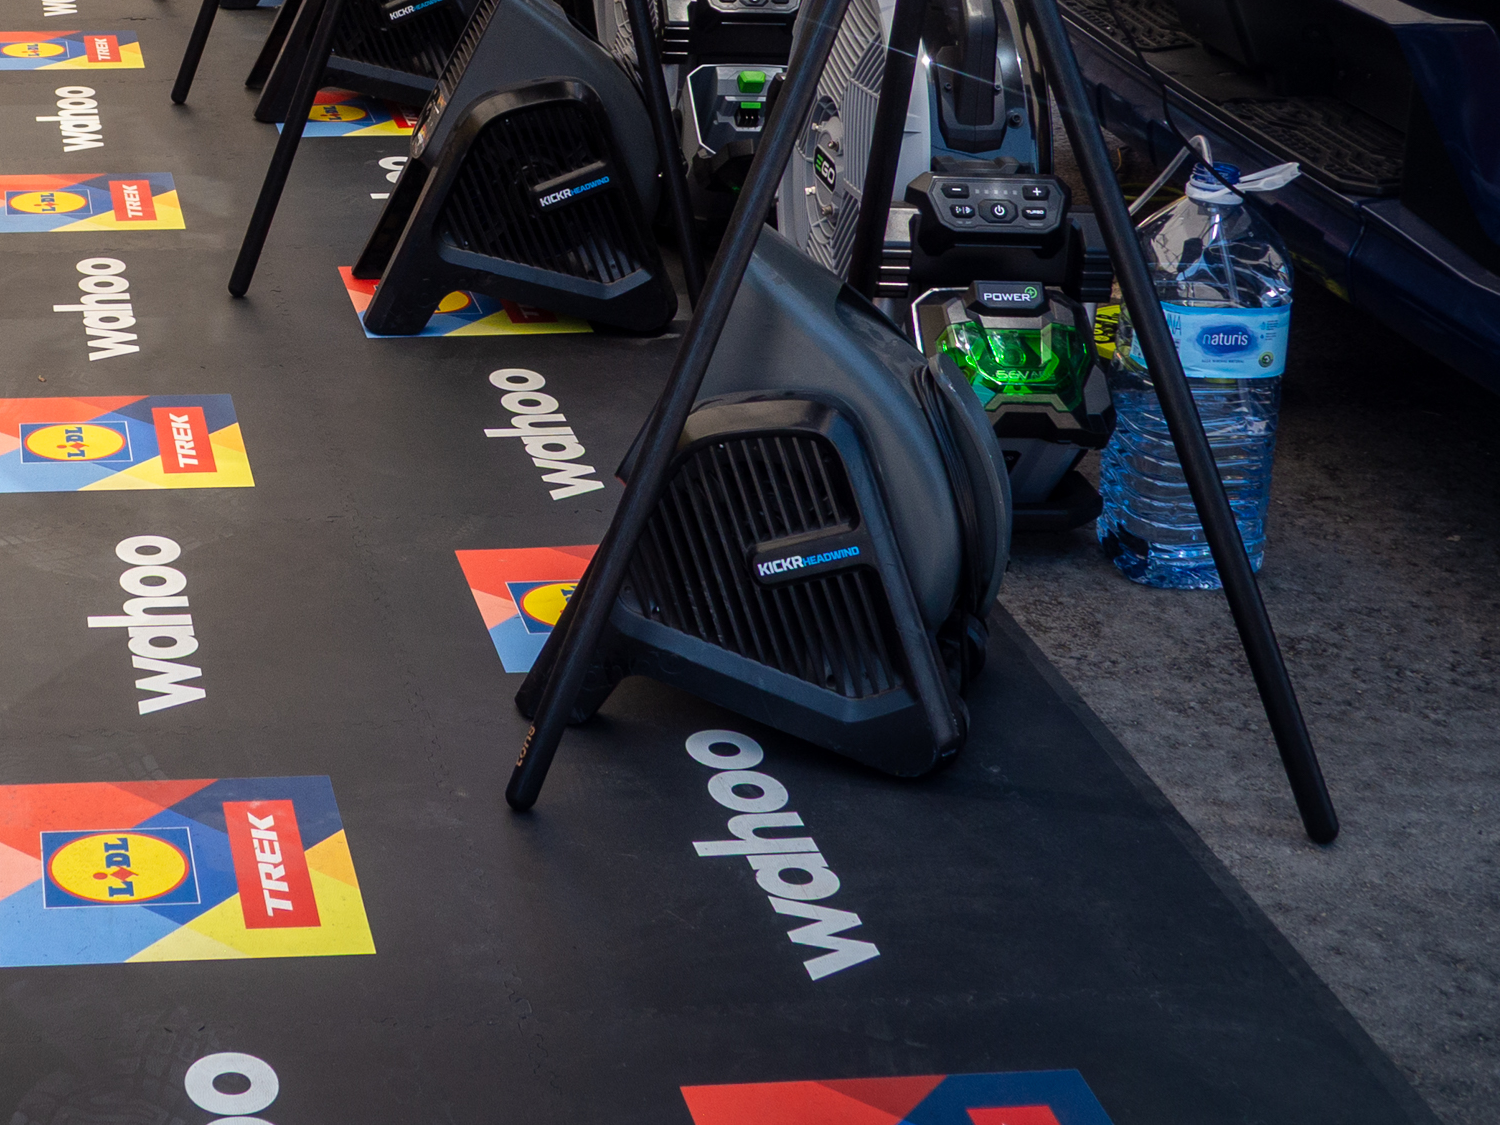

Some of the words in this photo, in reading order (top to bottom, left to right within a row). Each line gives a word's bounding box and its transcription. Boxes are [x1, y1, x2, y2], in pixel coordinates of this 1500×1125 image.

[389, 5, 415, 21] KICKR
[94, 37, 111, 61] TREK
[35, 85, 105, 153] wahoo
[539, 188, 572, 207] KICKR
[570, 175, 610, 197] HEADWIND
[815, 153, 836, 185] EGO
[122, 183, 143, 219] TREK
[52, 257, 141, 362] wahoo
[1201, 331, 1249, 346] naturis
[169, 412, 199, 468] TREK
[483, 368, 605, 501] wahoo
[757, 555, 804, 576] KICKR
[802, 545, 860, 567] HEADWIND
[87, 534, 207, 716] wahoo
[246, 811, 295, 917] TREK
[685, 729, 881, 982] wahoo
